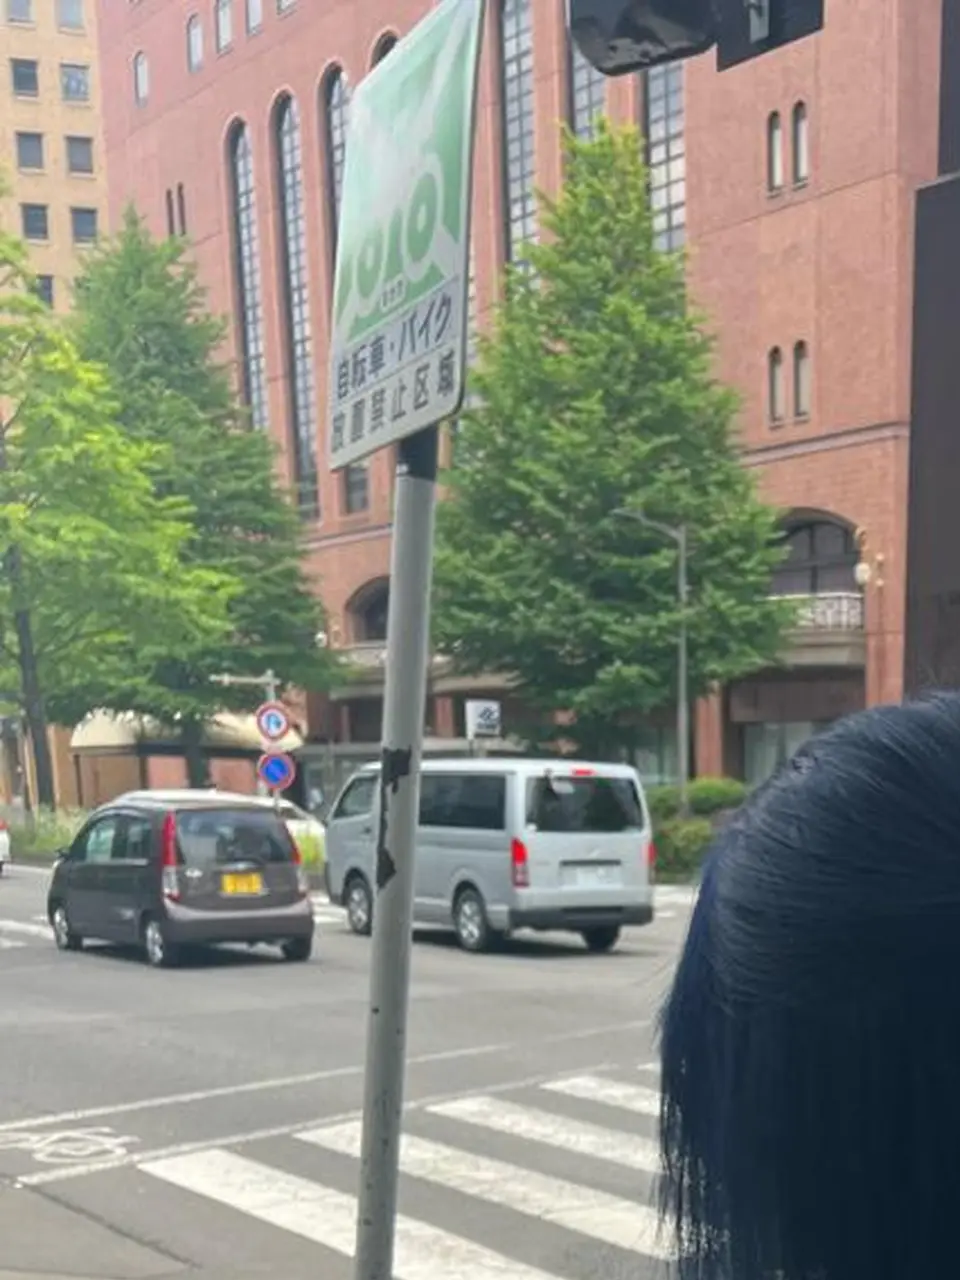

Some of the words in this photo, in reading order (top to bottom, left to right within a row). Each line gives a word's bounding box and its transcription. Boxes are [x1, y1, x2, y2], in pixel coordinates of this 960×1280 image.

[338, 292, 451, 400] 自転車・バイク
